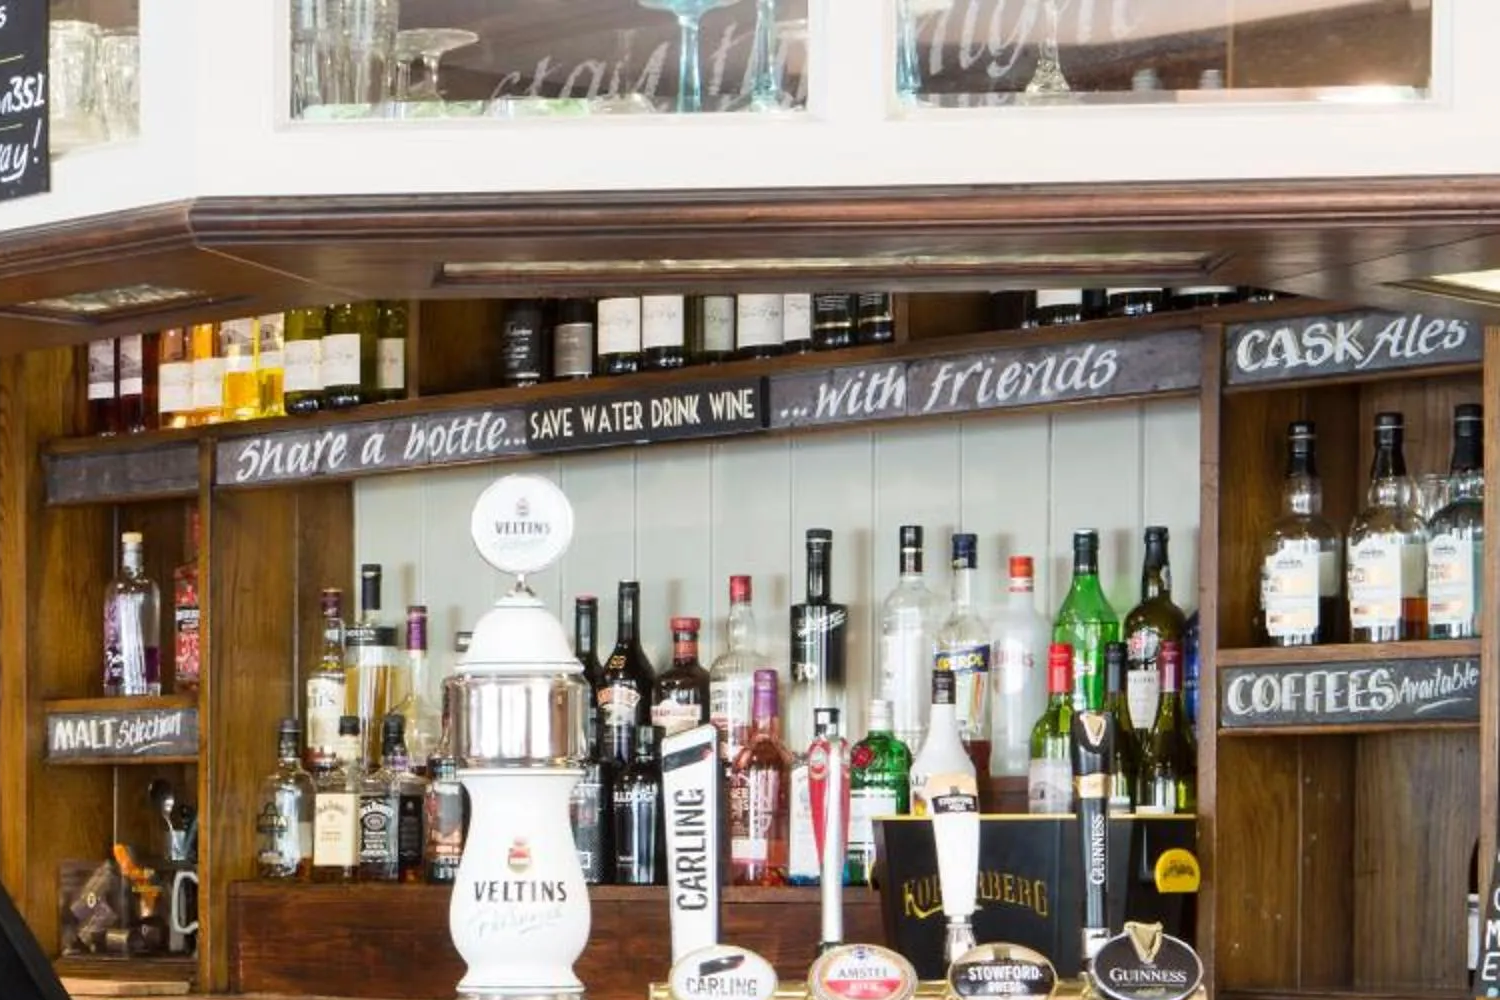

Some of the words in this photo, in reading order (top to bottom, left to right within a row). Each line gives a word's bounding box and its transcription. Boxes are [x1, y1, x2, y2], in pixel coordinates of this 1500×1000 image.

[1235, 317, 1365, 373] CASK
[1354, 314, 1469, 369] Ales
[923, 342, 1120, 412] friends
[530, 409, 574, 440] SAVE
[580, 400, 644, 435] WATER
[650, 394, 703, 428] DRINK
[708, 387, 756, 422] WINE
[235, 431, 347, 484] Share
[360, 433, 386, 466] a
[495, 520, 552, 535] VELTINS
[1226, 666, 1400, 716] COFFEES
[1398, 662, 1481, 703] Available
[54, 717, 118, 751] MALT
[115, 712, 182, 749] Selection
[674, 788, 708, 912] CARLING
[1091, 814, 1106, 885] GUINNESS
[474, 880, 568, 902] VELTINS
[904, 868, 1048, 918] KOPBERG
[686, 975, 758, 997] CARLING
[967, 963, 1040, 982] STOWFORD
[1109, 967, 1188, 984] GUINNESS
